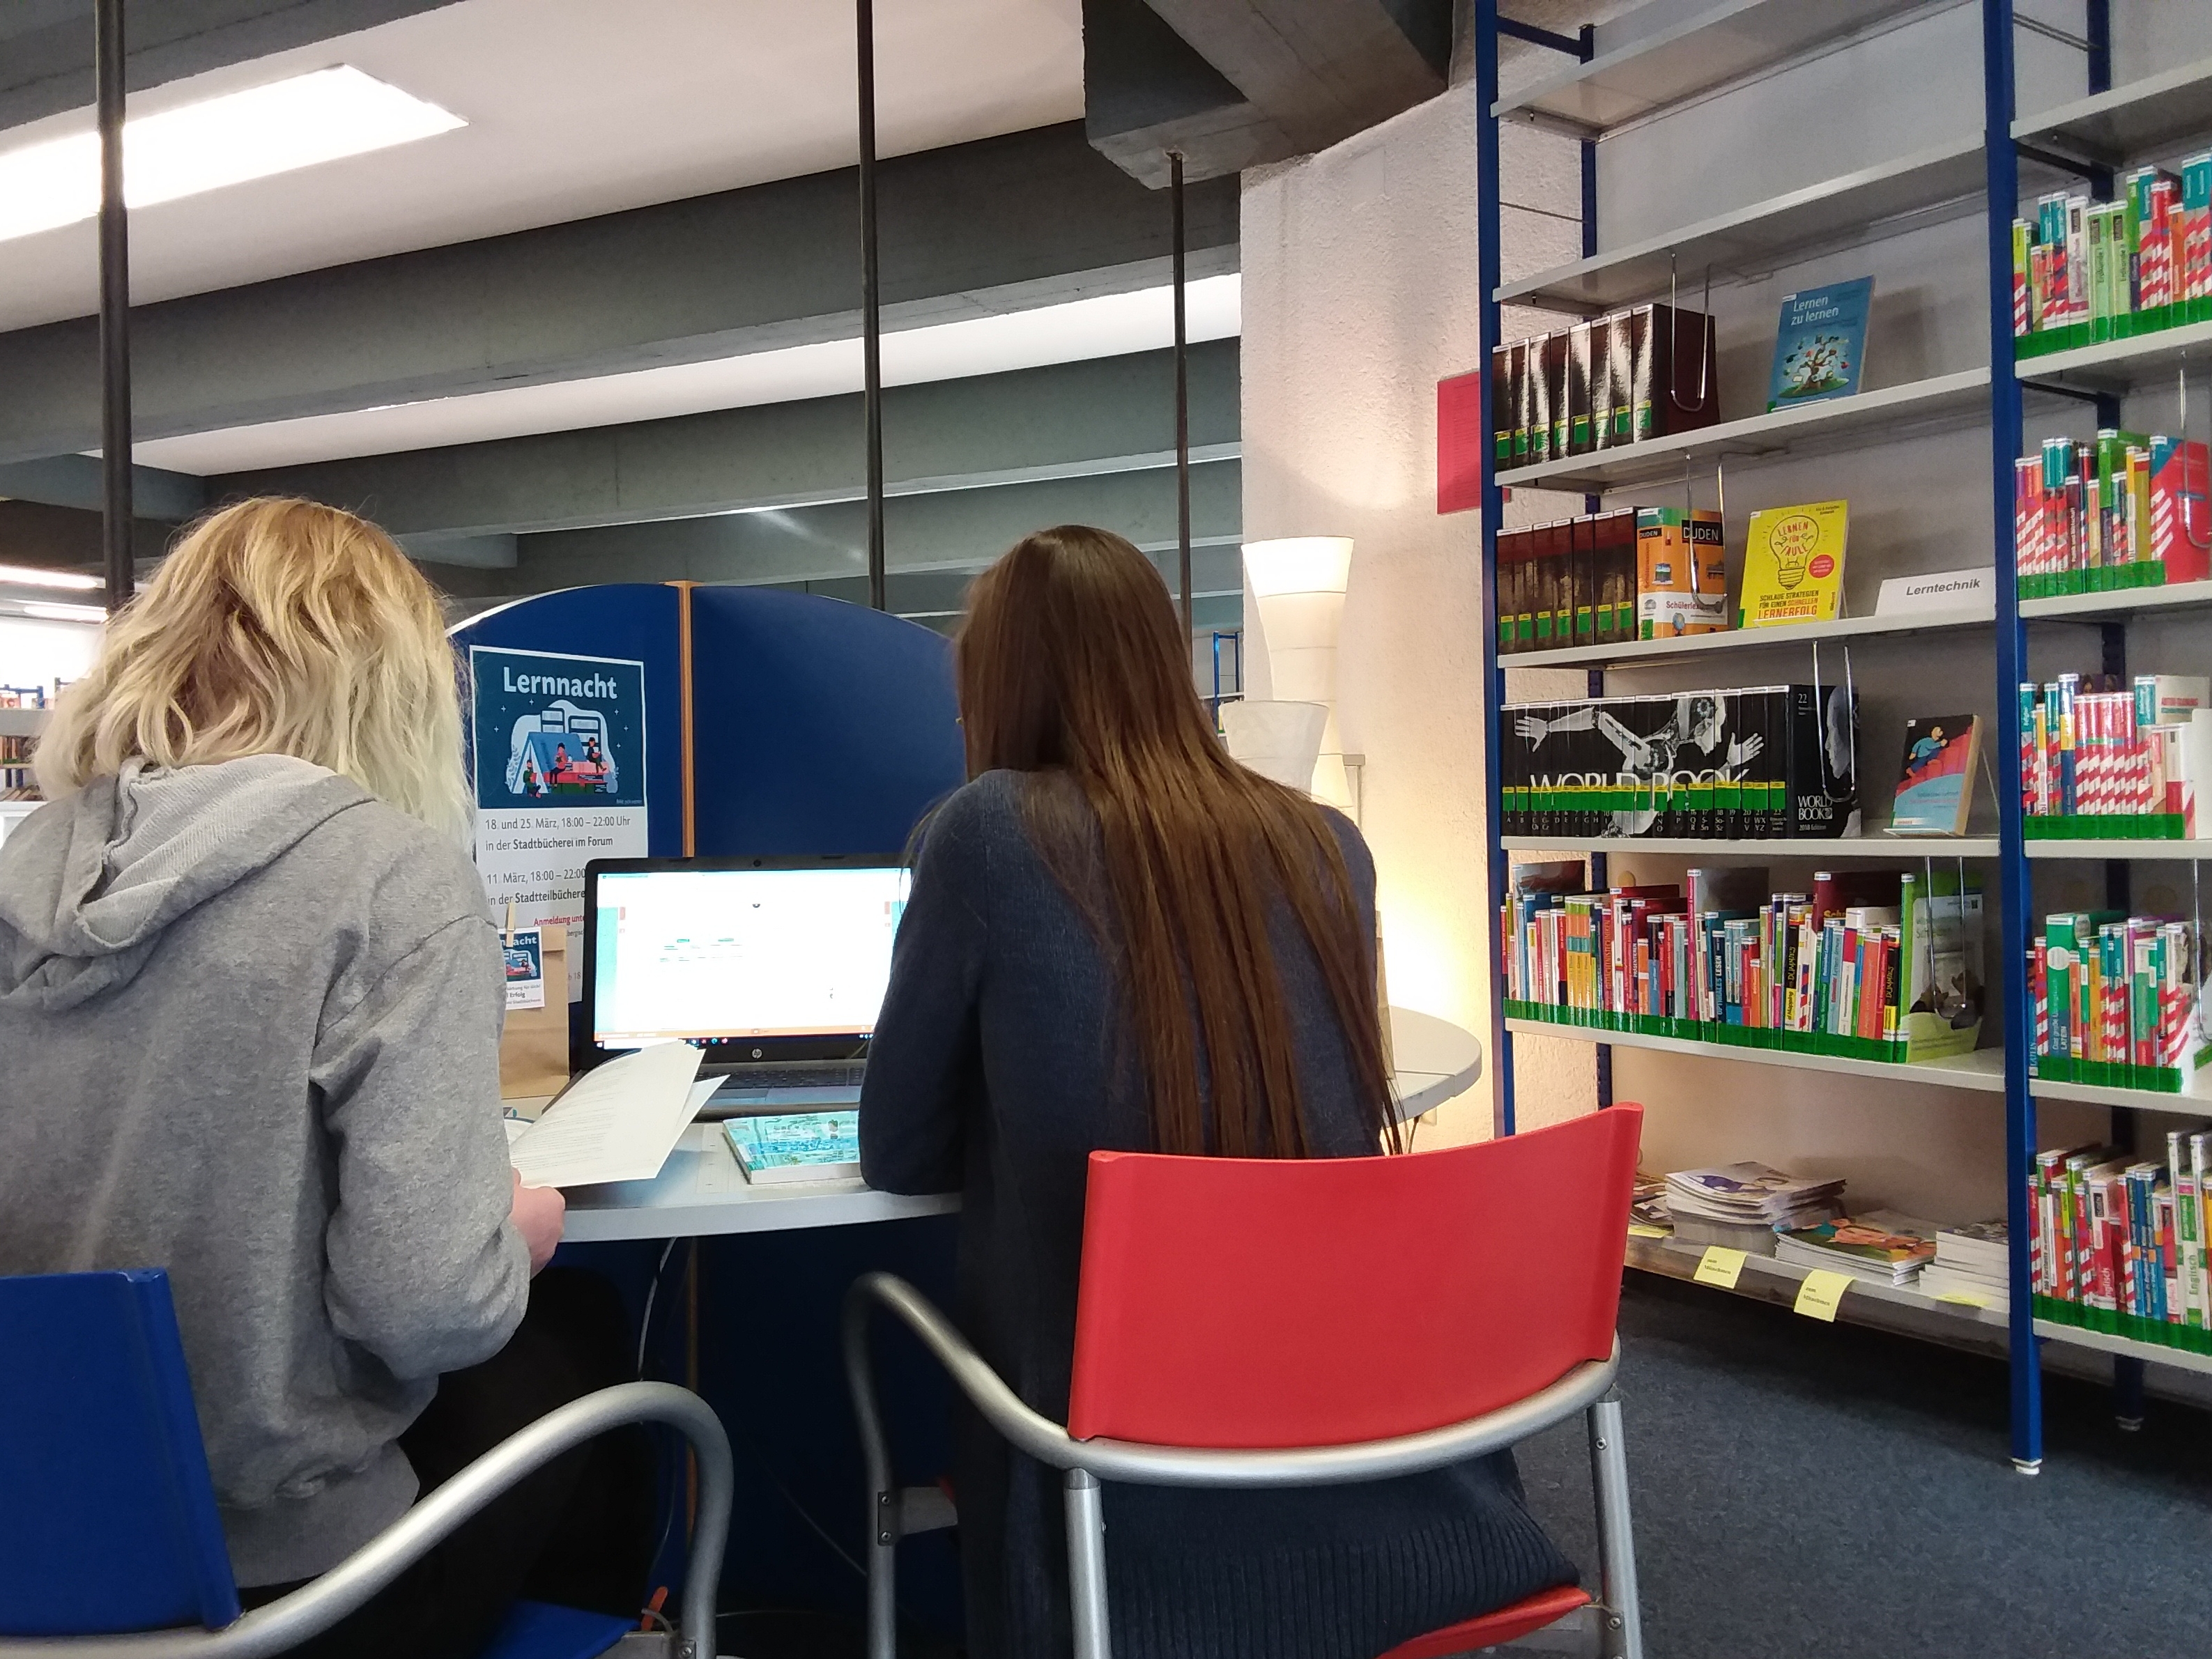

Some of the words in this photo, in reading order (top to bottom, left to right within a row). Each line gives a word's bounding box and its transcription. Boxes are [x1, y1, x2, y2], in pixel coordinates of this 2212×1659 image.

[1793, 296, 1829, 312] Lernen
[1790, 314, 1803, 326] zu
[1805, 307, 1839, 323] lernen
[1639, 530, 1658, 539] DUDEN
[1683, 526, 1719, 541] DUDEN
[1778, 521, 1809, 537] LERNEN
[1785, 590, 1818, 599] STRATEGIEN
[1906, 578, 1981, 596] Lerntechnik
[1758, 605, 1818, 619] LERNERFOLG
[504, 666, 618, 699] Lernnacht
[1798, 694, 1807, 704] 22
[1798, 795, 1833, 808] WORLD
[1689, 817, 1696, 825] Q
[1798, 808, 1825, 820] BOOK
[501, 818, 518, 829] und
[535, 817, 559, 830] März,
[561, 817, 584, 828] 18:00
[593, 816, 615, 827] 22:00
[616, 815, 631, 826] Uhr
[486, 840, 494, 851] in
[496, 839, 512, 850] der
[513, 837, 574, 849] Stadtbücherei
[575, 838, 586, 847] im
[587, 836, 613, 847] Forum
[502, 872, 528, 885] März,
[530, 870, 554, 881] 18:00
[563, 869, 585, 880] 22:00
[488, 895, 496, 905] in
[498, 893, 514, 904] der
[534, 915, 570, 927] Anmeldung
[1788, 946, 1796, 980] DUMMIES
[1886, 966, 1894, 998] DUMMIES
[752, 1048, 762, 1059] hp
[2101, 1267, 2112, 1297] nglisch
[2188, 1254, 2200, 1295] Englisch
